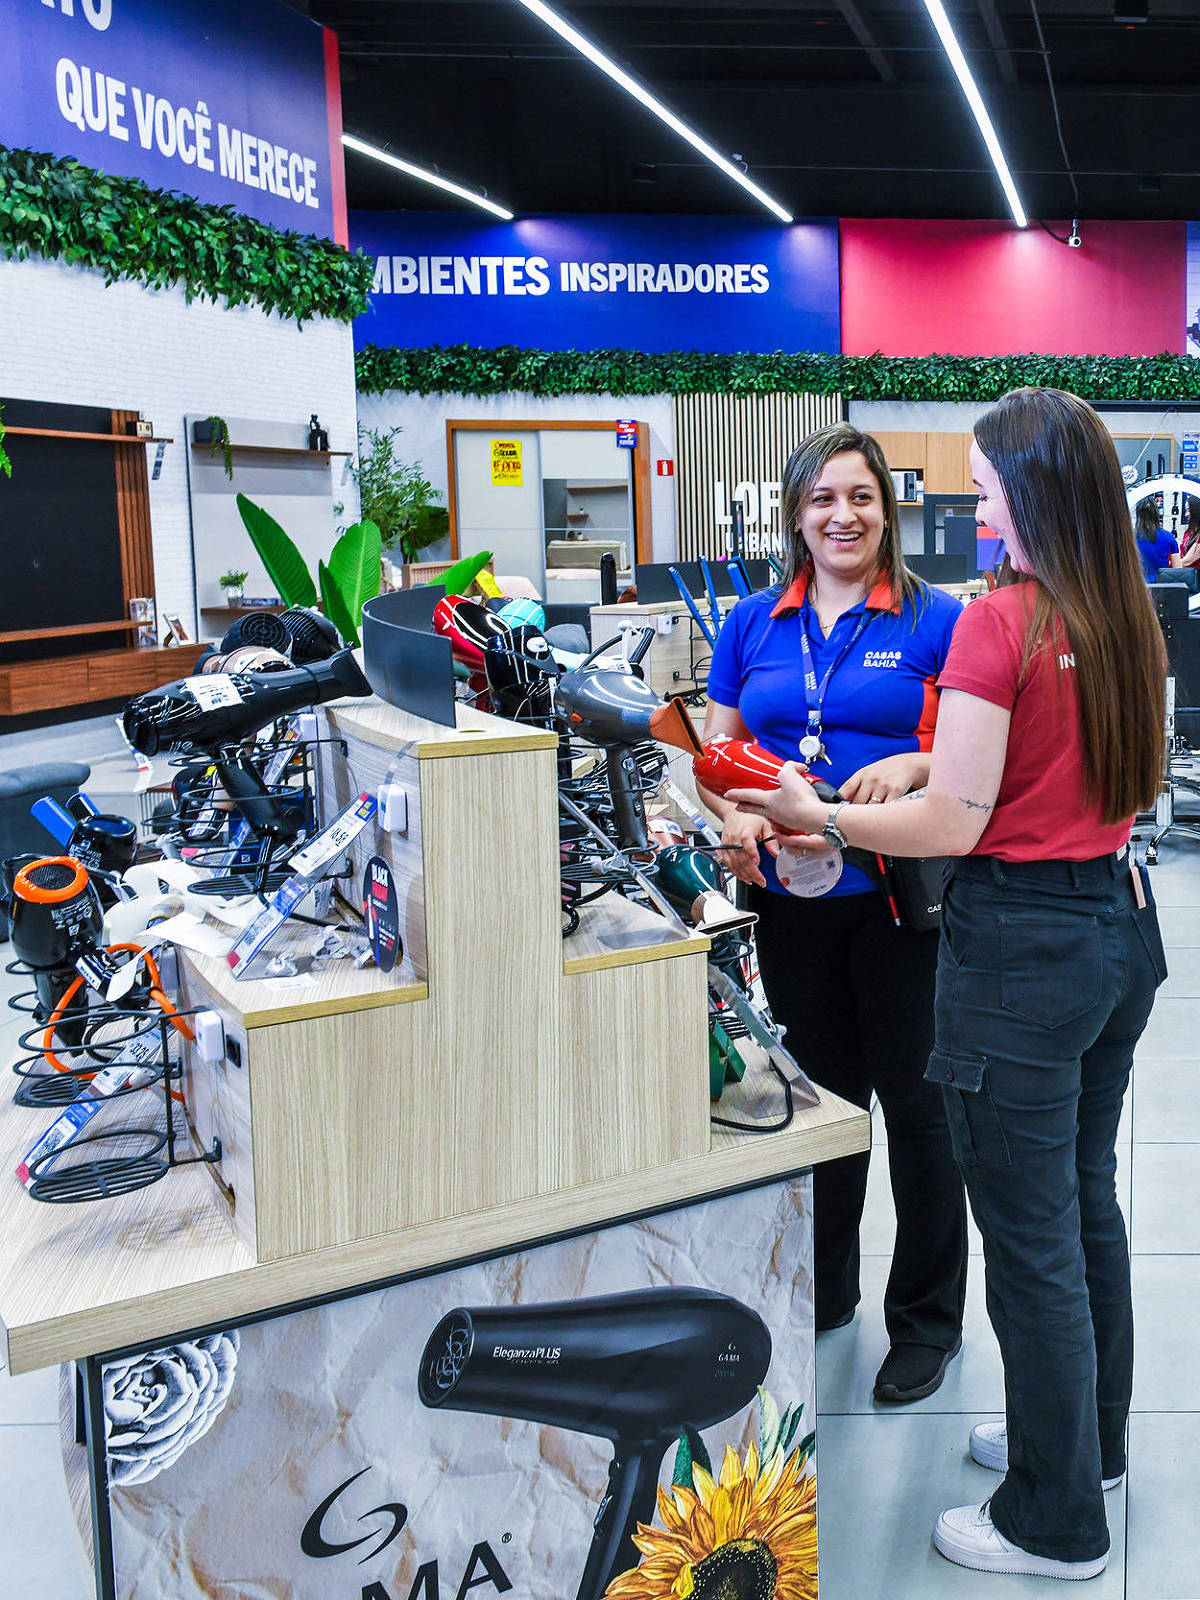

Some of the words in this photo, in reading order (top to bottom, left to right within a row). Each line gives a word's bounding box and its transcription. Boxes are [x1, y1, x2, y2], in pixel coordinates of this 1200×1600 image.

[56, 58, 129, 141] QUE
[131, 86, 214, 172] VOCÊ
[218, 122, 320, 209] MERECE
[372, 256, 550, 297] MBIENTES
[560, 262, 770, 294] INSPIRADORES
[714, 481, 784, 525] LOF
[863, 659, 897, 668] BAHIA
[865, 651, 902, 660] CASAS
[492, 1345, 561, 1361] EleganzaPLUS
